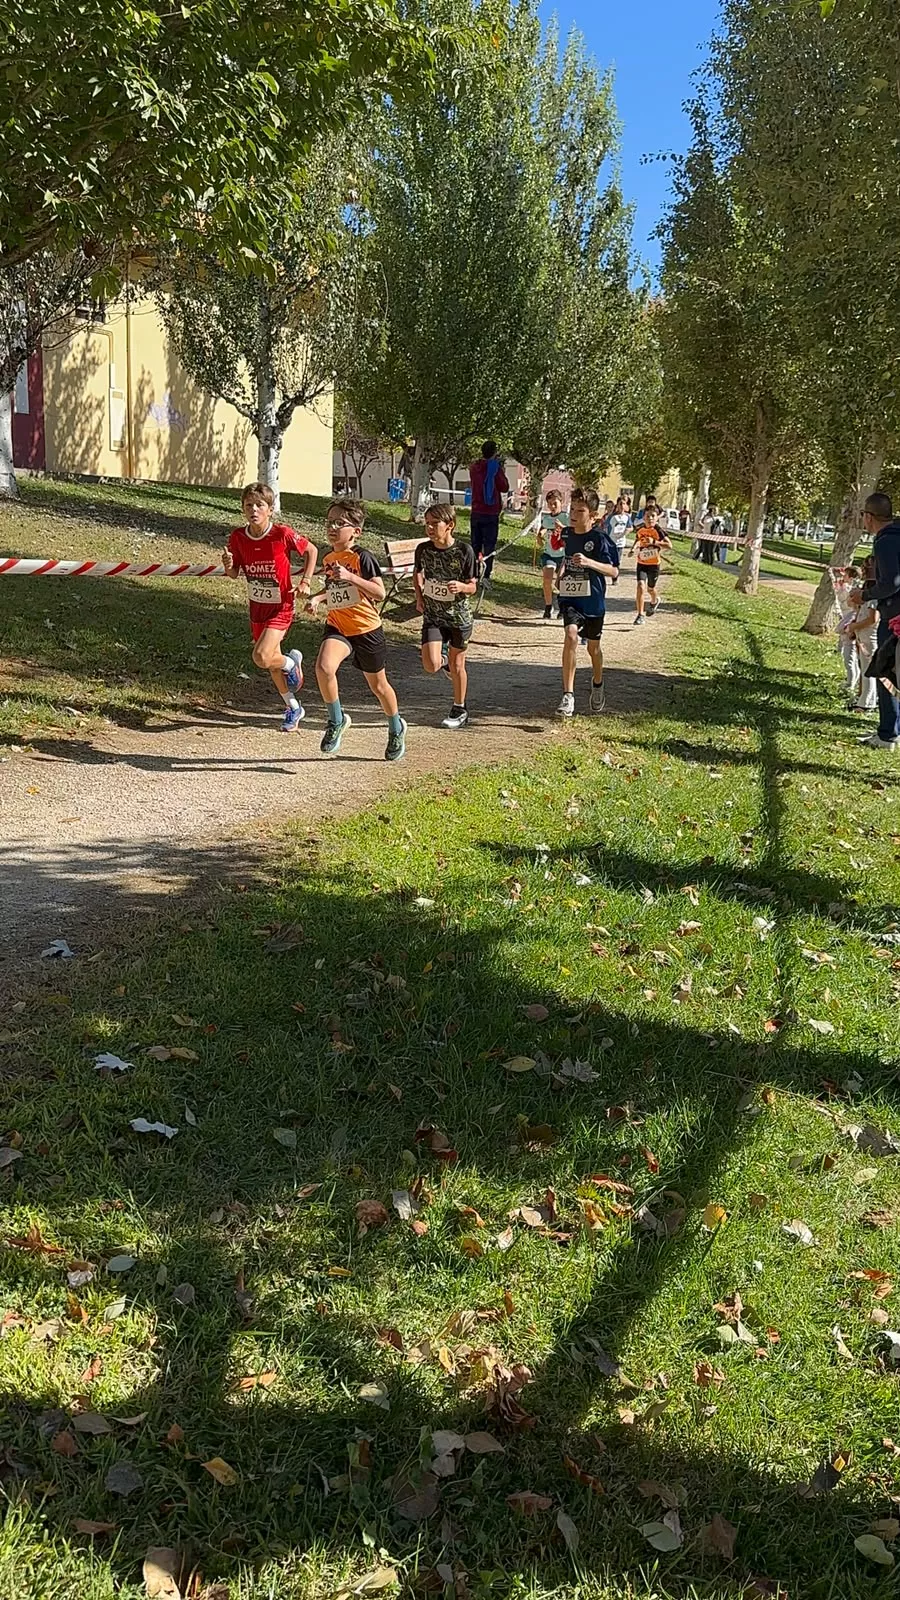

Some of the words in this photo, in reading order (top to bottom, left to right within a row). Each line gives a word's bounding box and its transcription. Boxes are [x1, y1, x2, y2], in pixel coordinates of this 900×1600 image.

[252, 587, 273, 599] 273
[430, 585, 448, 597] 129
[565, 583, 583, 592] 237
[330, 590, 351, 604] 364
